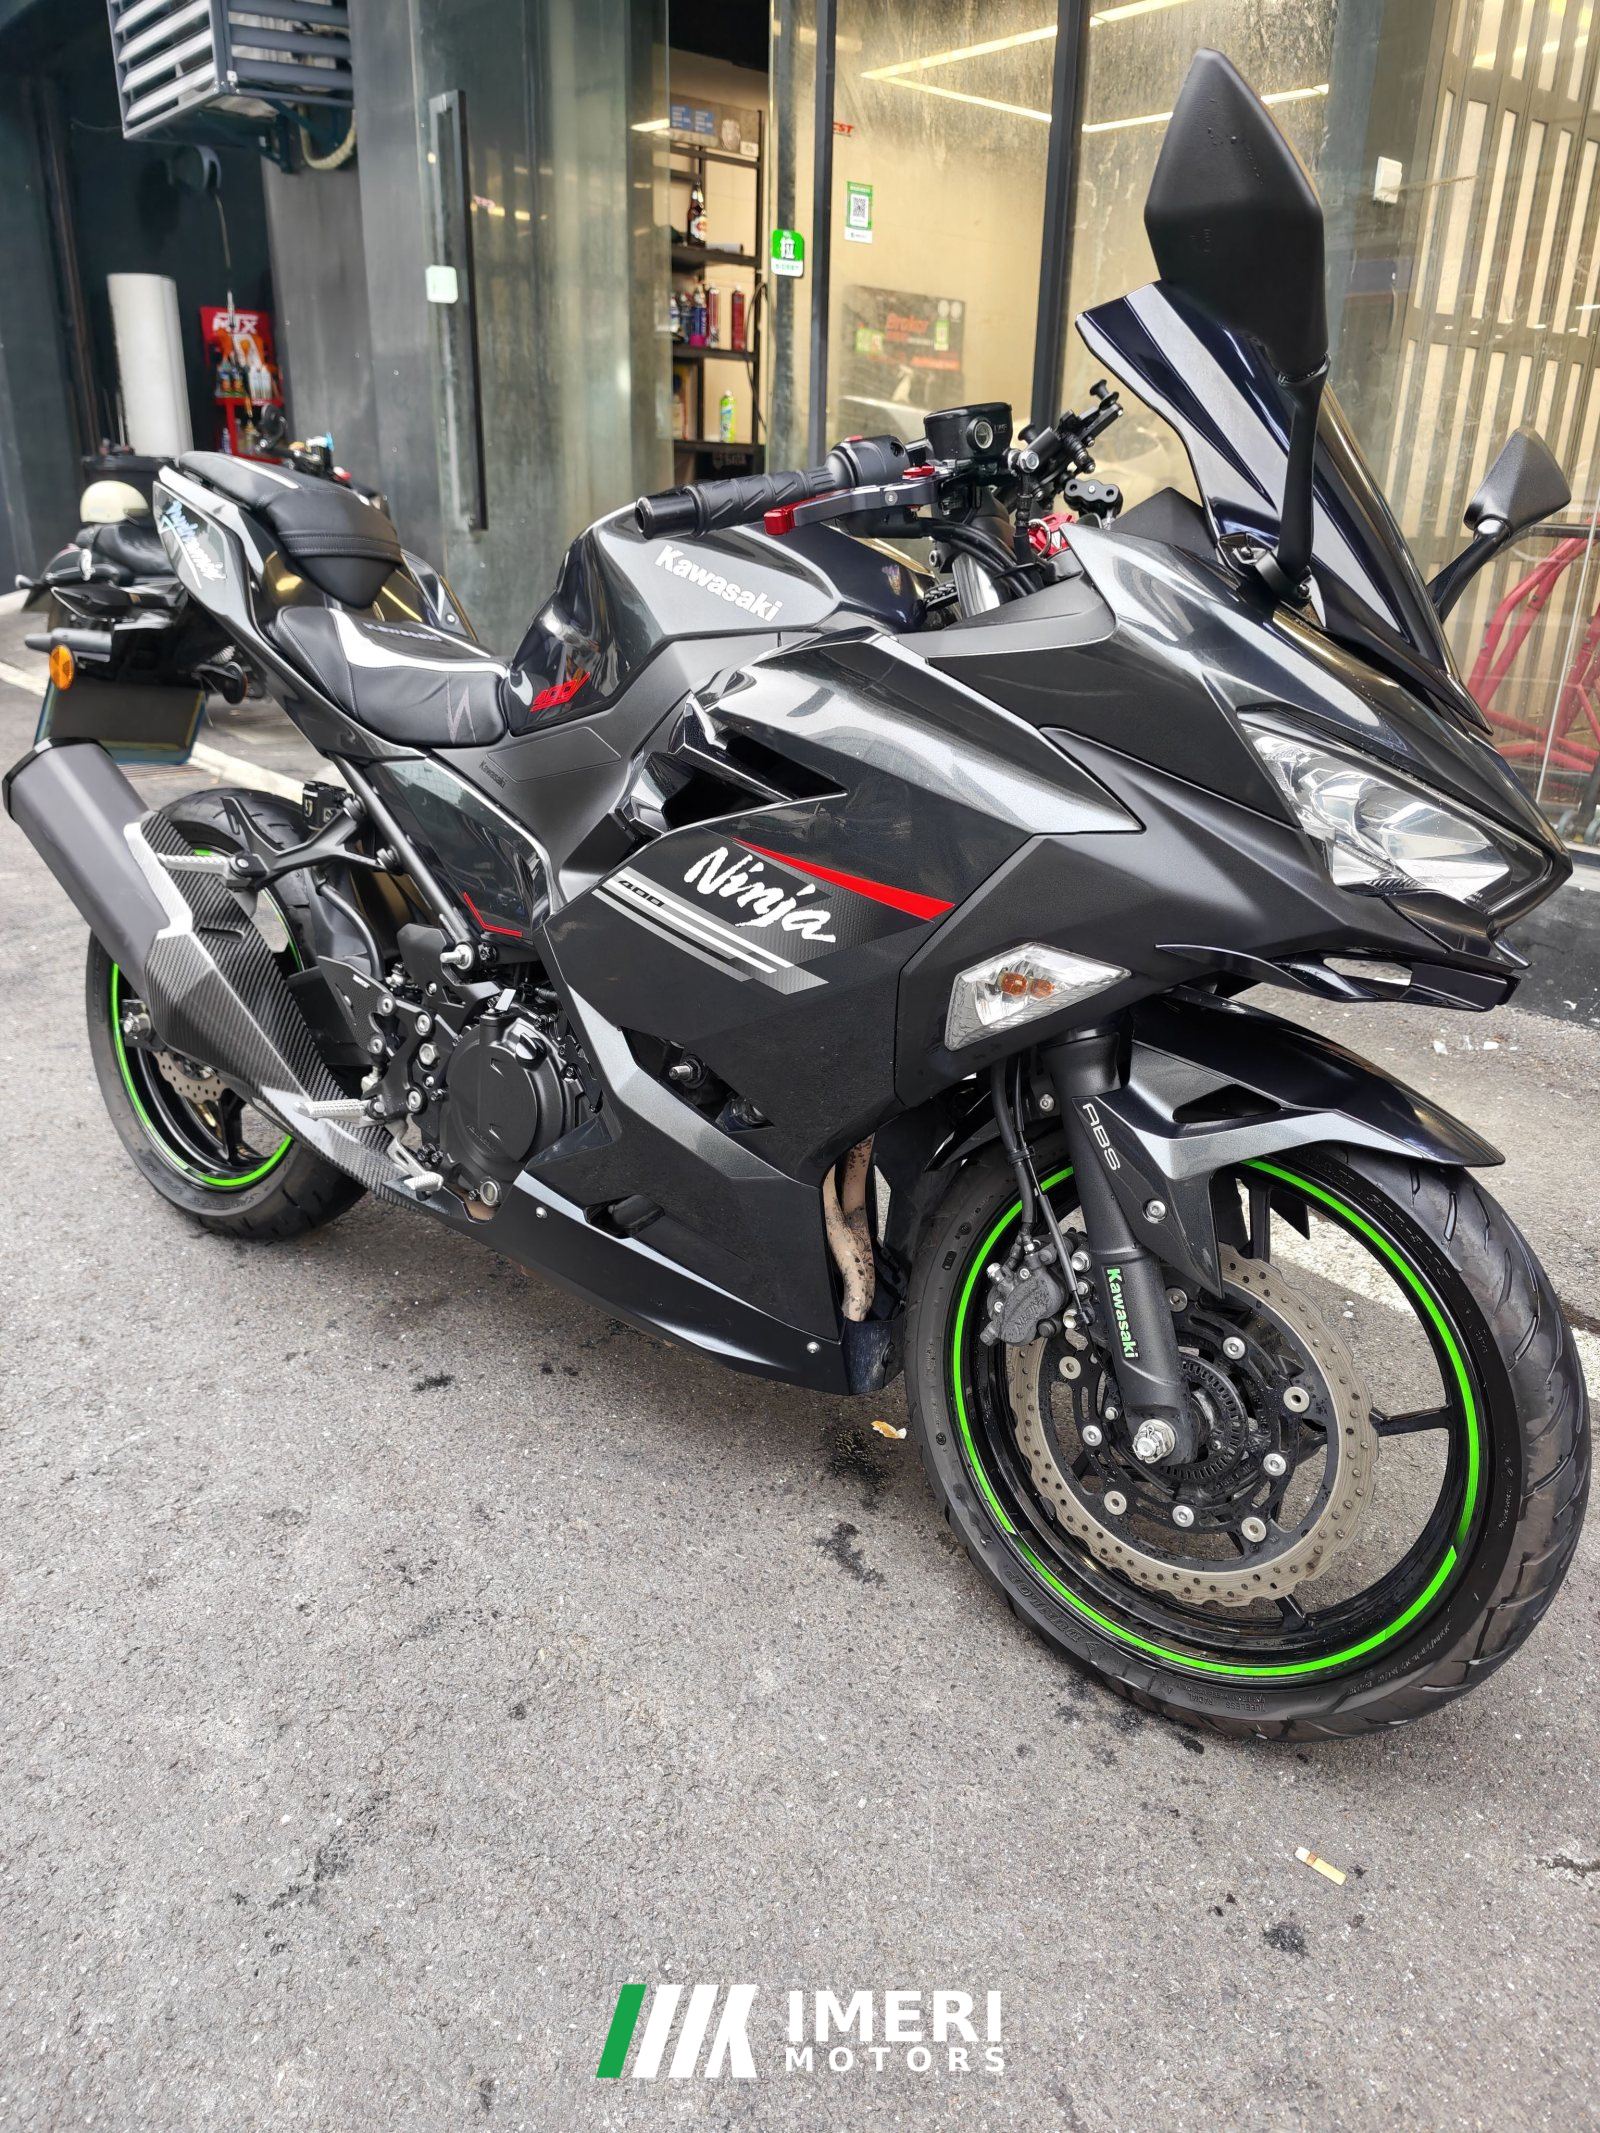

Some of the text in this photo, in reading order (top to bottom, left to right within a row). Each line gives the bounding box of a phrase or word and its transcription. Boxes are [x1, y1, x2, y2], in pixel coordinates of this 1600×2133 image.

[655, 545, 783, 622] Kawasaki
[479, 761, 507, 789] Kawasaki
[618, 879, 665, 908] 400
[684, 846, 836, 943] Ninja
[1083, 1103, 1120, 1170] ABS
[1106, 1268, 1138, 1359] Kawasaki
